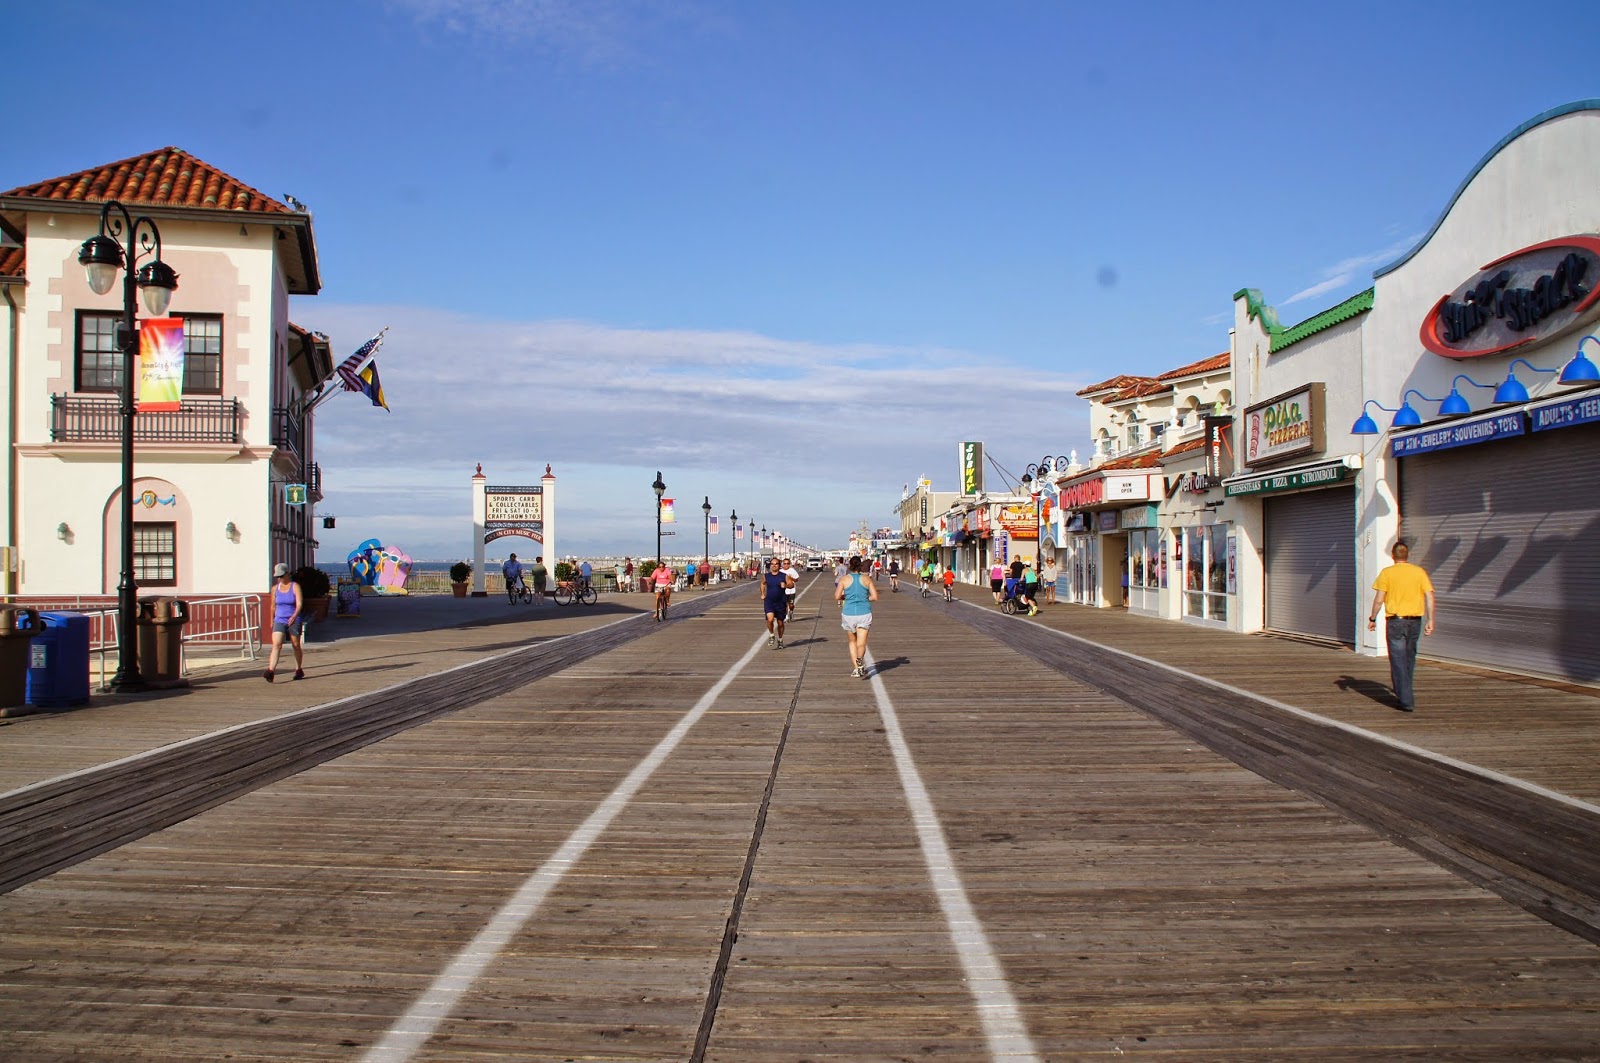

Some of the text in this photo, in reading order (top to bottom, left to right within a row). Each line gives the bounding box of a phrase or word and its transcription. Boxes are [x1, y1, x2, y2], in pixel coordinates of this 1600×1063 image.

[1538, 398, 1600, 427] ADULT'S TEE
[1212, 426, 1221, 456] verizon
[1269, 420, 1311, 447] PIZZERIA
[1406, 436, 1418, 451] ATM
[1454, 420, 1493, 441] SOUVENIRS
[1497, 416, 1519, 433] TOYS
[966, 444, 975, 492] SUBWAY
[1228, 481, 1261, 495] CHEESESTEAKS
[1272, 476, 1288, 488] PIZZA
[1301, 468, 1337, 484] STROMBOLI
[1180, 472, 1205, 493] verizon
[516, 529, 531, 537] MUSIC
[531, 533, 542, 541] PIER
